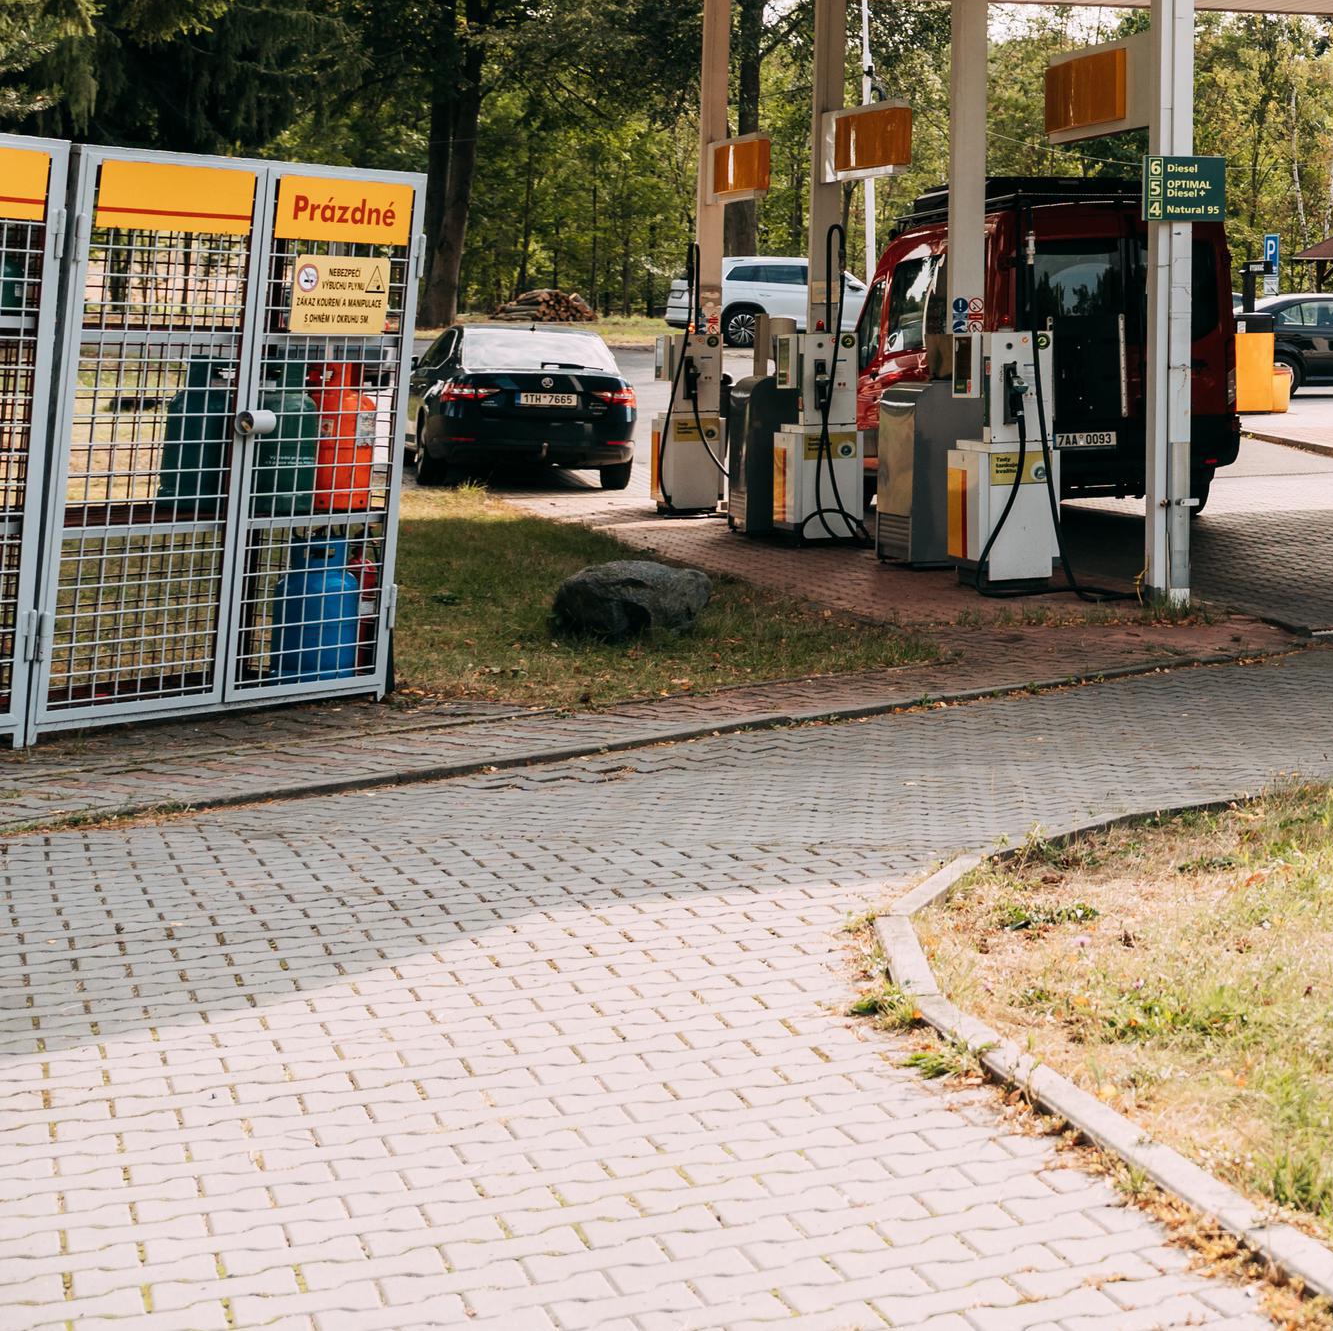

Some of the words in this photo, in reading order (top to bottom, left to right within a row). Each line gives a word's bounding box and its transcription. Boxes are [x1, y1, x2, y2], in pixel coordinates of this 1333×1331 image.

[1151, 161, 1161, 175] 6
[1167, 164, 1198, 173] Diesel
[1150, 181, 1161, 195] 5
[1166, 180, 1212, 189] OPTIMAL
[1166, 189, 1198, 197] Diesel
[293, 195, 396, 227] Prázdné
[1149, 201, 1161, 216] 4
[1166, 205, 1205, 214] Natural
[1207, 206, 1220, 214] 95
[1267, 240, 1276, 261] P
[322, 279, 348, 290] VÝBUCHU
[348, 281, 366, 290] PLYNU
[296, 296, 316, 307] ZÁKAZ
[342, 298, 347, 307] A
[348, 298, 382, 308] MANIPULACE
[304, 313, 308, 323] S
[332, 314, 336, 323] V
[337, 314, 358, 323] OKRUHU
[523, 394, 542, 403] 1TH
[549, 395, 573, 404] 7665
[1058, 434, 1078, 446] 7AA
[1085, 433, 1112, 444] 0093
